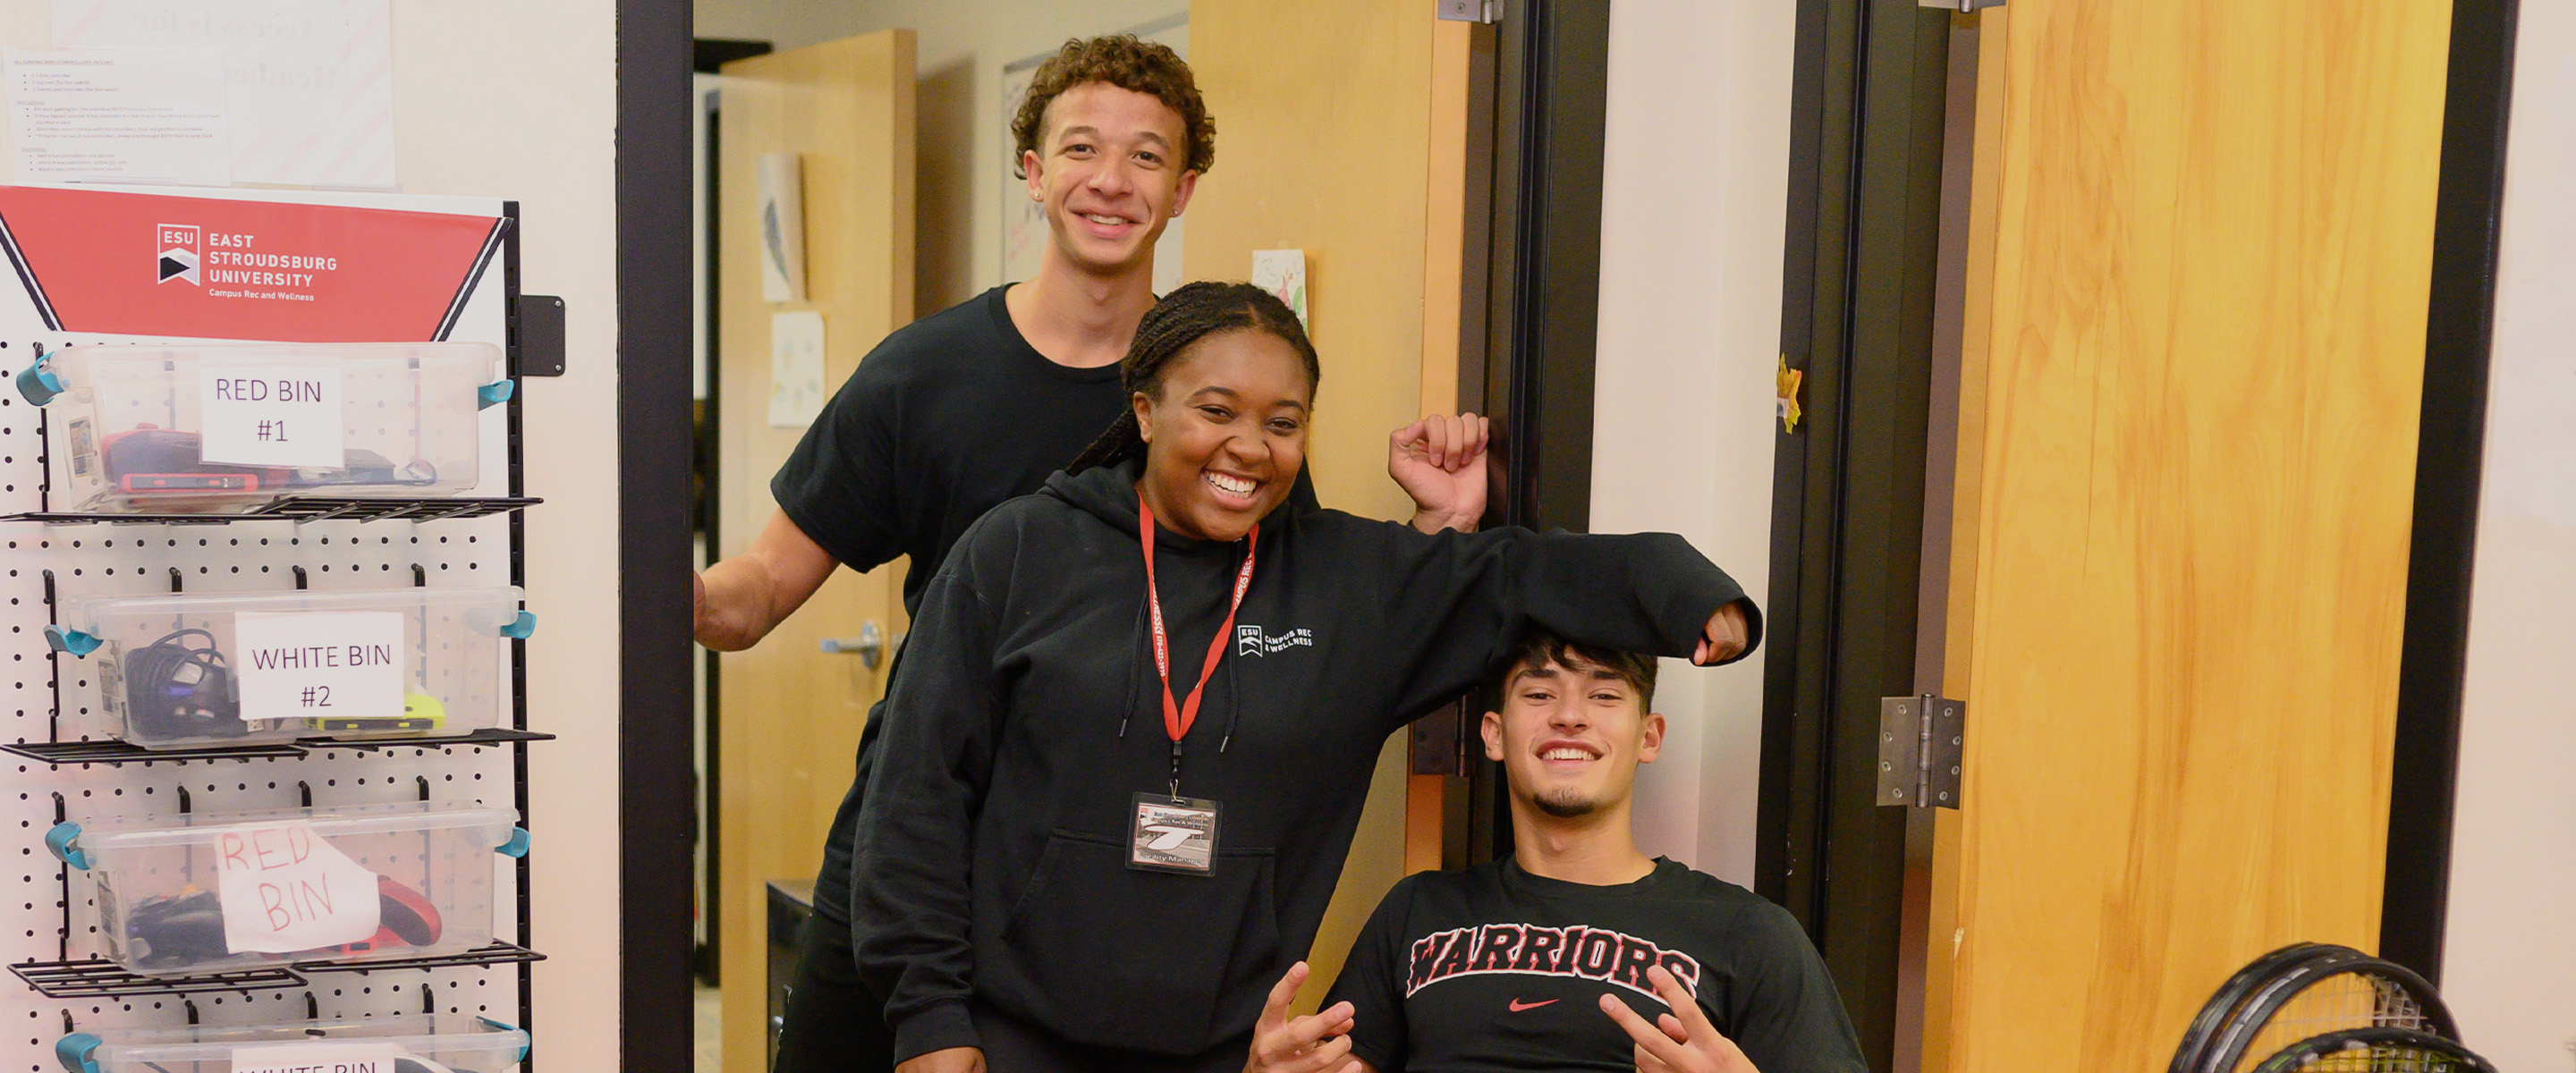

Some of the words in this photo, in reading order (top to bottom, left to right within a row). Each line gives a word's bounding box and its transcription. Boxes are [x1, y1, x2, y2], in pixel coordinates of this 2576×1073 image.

[164, 231, 194, 244] ESU
[209, 232, 254, 248] EAST
[209, 251, 337, 271] STROUDSBURG
[209, 269, 313, 287] UNIVERSITY
[209, 288, 242, 299] Campus
[244, 290, 258, 299] Rec
[260, 291, 275, 300] and
[277, 291, 314, 301] Wellness
[216, 378, 268, 401] RED
[279, 380, 321, 402] BIN
[258, 420, 288, 442] #1
[1265, 629, 1295, 645] CAMPUS
[1297, 629, 1312, 637] REC
[252, 646, 339, 670] WHITE
[349, 644, 391, 666] BIN
[301, 686, 332, 707] #2
[222, 827, 309, 870] RED
[258, 873, 333, 932] BIN
[1406, 923, 1700, 1008] WARRIORS
